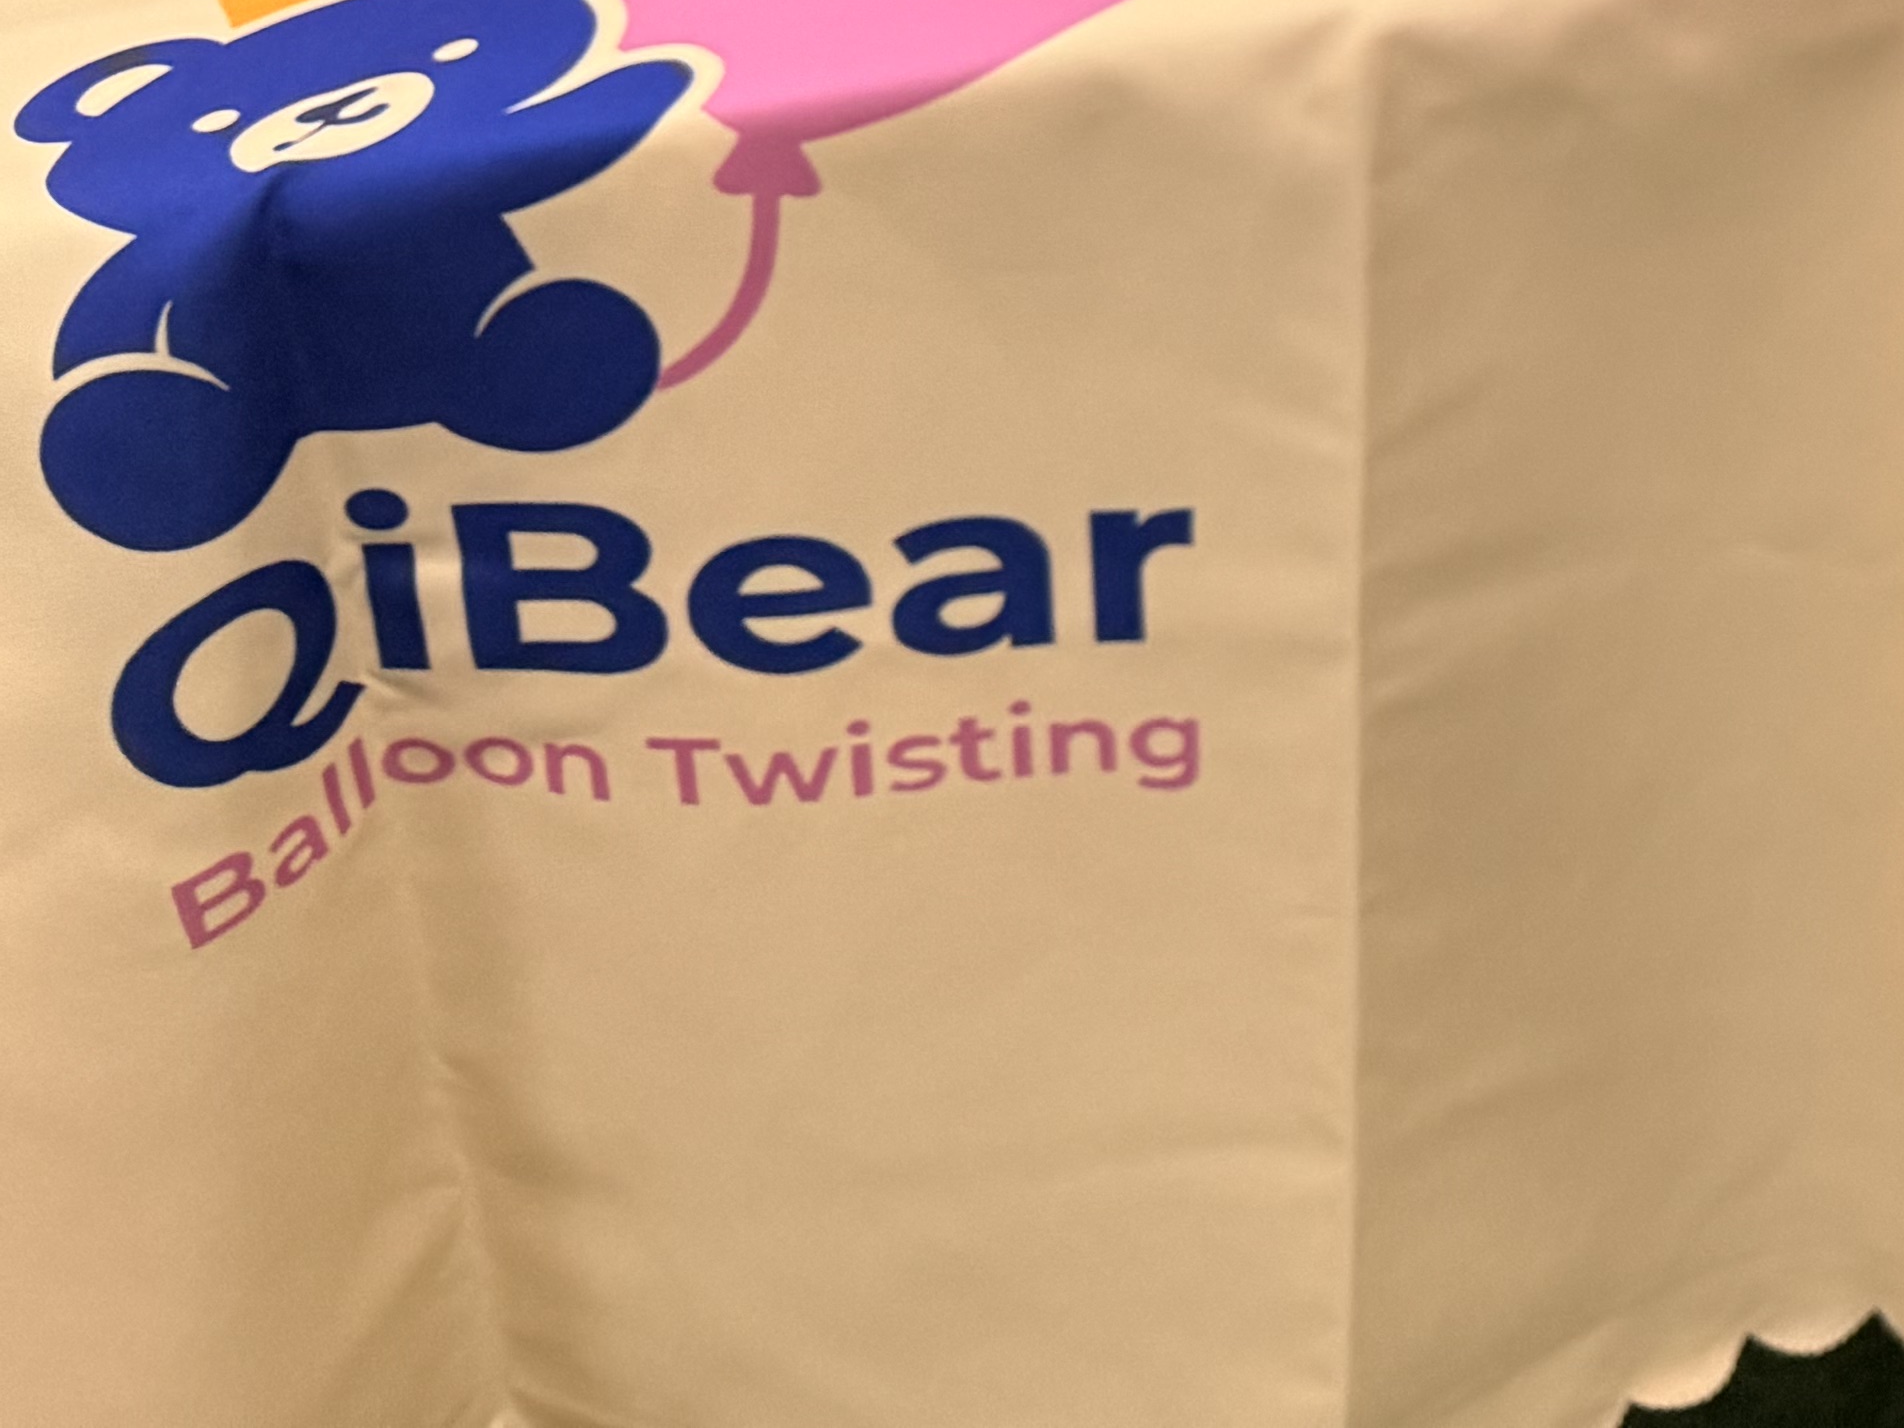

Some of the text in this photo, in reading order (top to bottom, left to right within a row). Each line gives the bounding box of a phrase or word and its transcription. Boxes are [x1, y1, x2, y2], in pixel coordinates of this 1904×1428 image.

[110, 488, 1195, 789] QiBear
[170, 701, 1201, 950] Balloon Twisting
